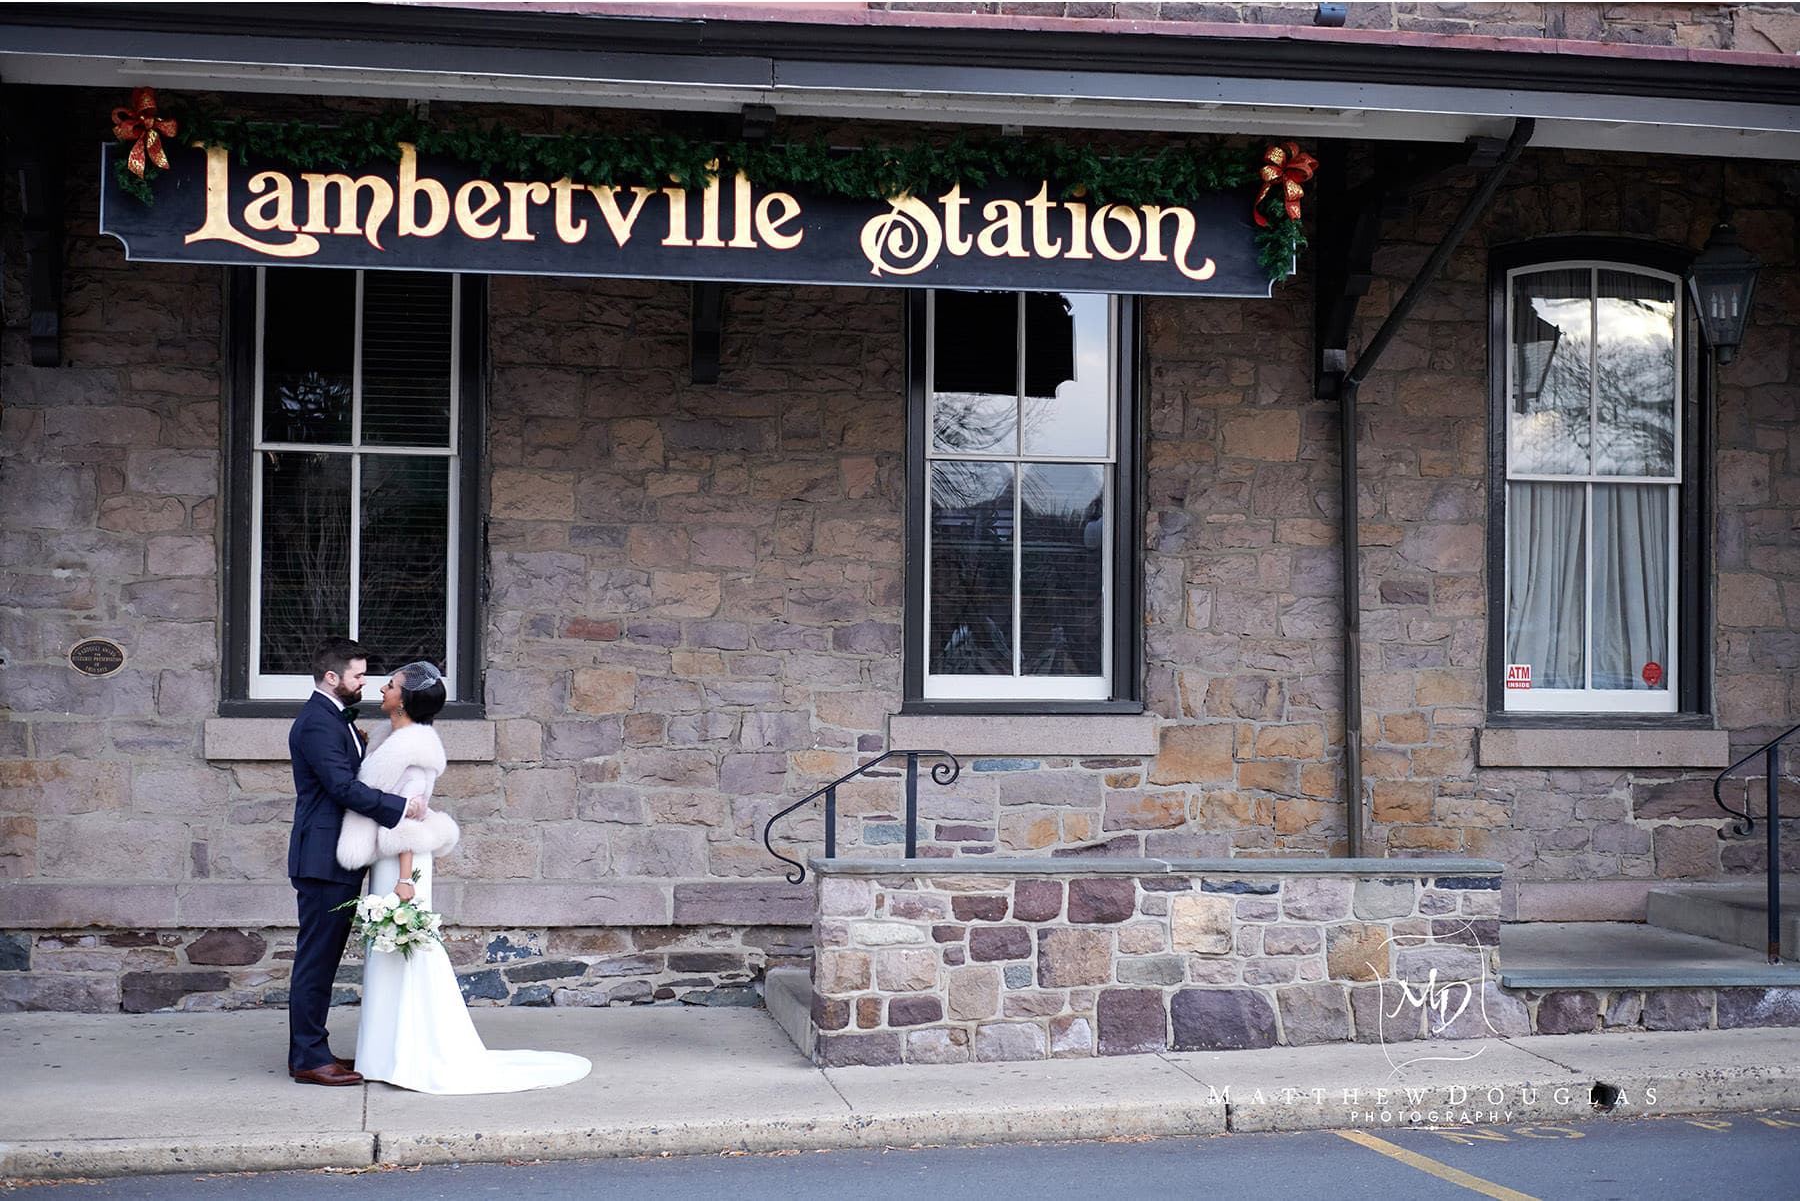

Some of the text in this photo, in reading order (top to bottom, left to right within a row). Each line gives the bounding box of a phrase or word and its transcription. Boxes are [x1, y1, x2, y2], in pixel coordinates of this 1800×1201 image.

[184, 140, 1216, 281] Lambertville Station
[1508, 666, 1530, 679] ATM
